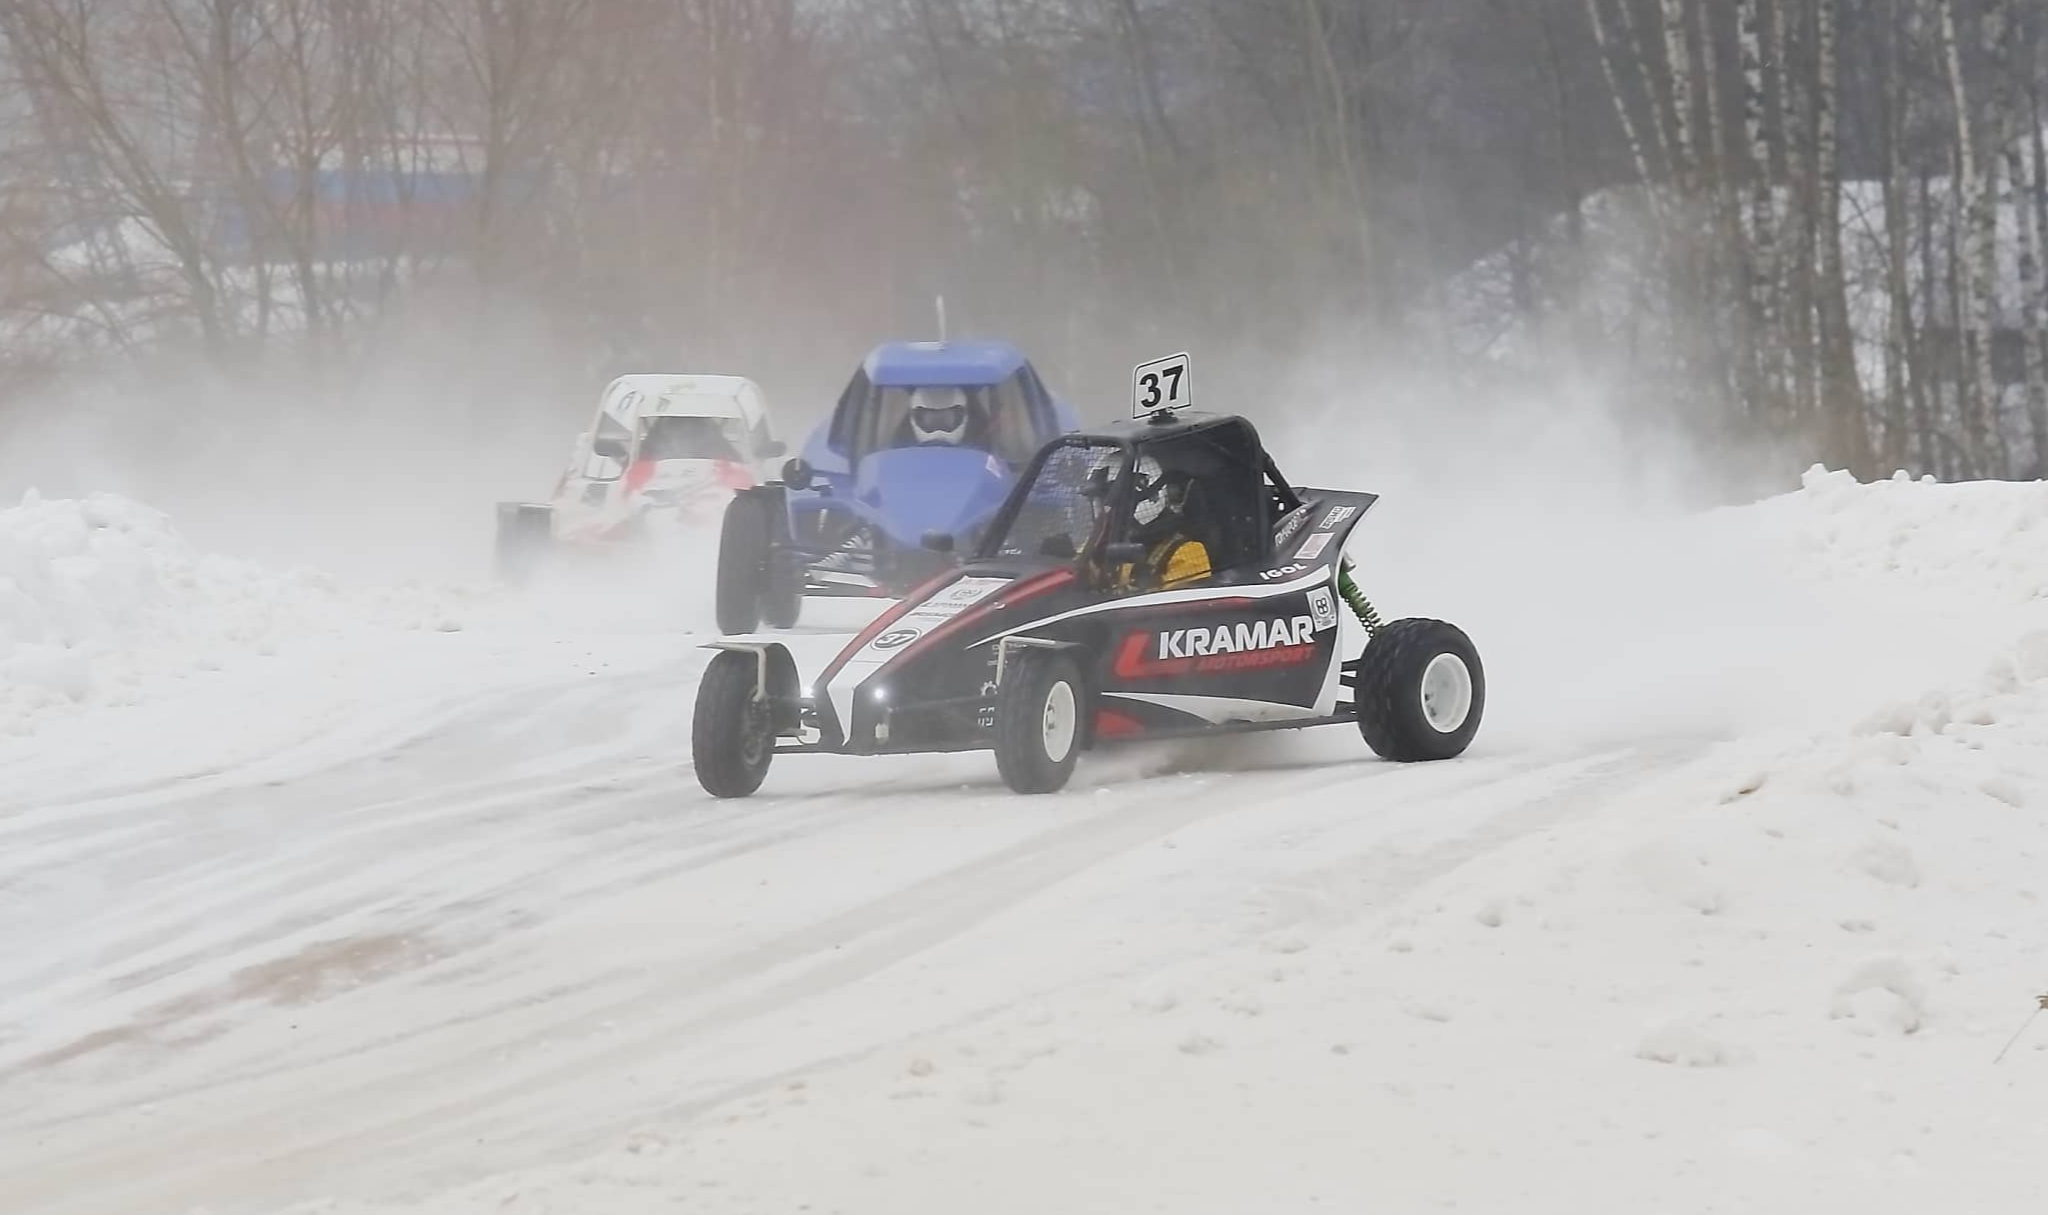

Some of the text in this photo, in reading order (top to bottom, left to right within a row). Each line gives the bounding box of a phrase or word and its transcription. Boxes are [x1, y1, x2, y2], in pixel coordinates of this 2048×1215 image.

[1139, 365, 1184, 408] 37
[1259, 563, 1308, 581] IGOL
[876, 632, 917, 646] 37
[1158, 615, 1315, 660] KRAMAR
[1196, 646, 1315, 671] MOTORSPORT
